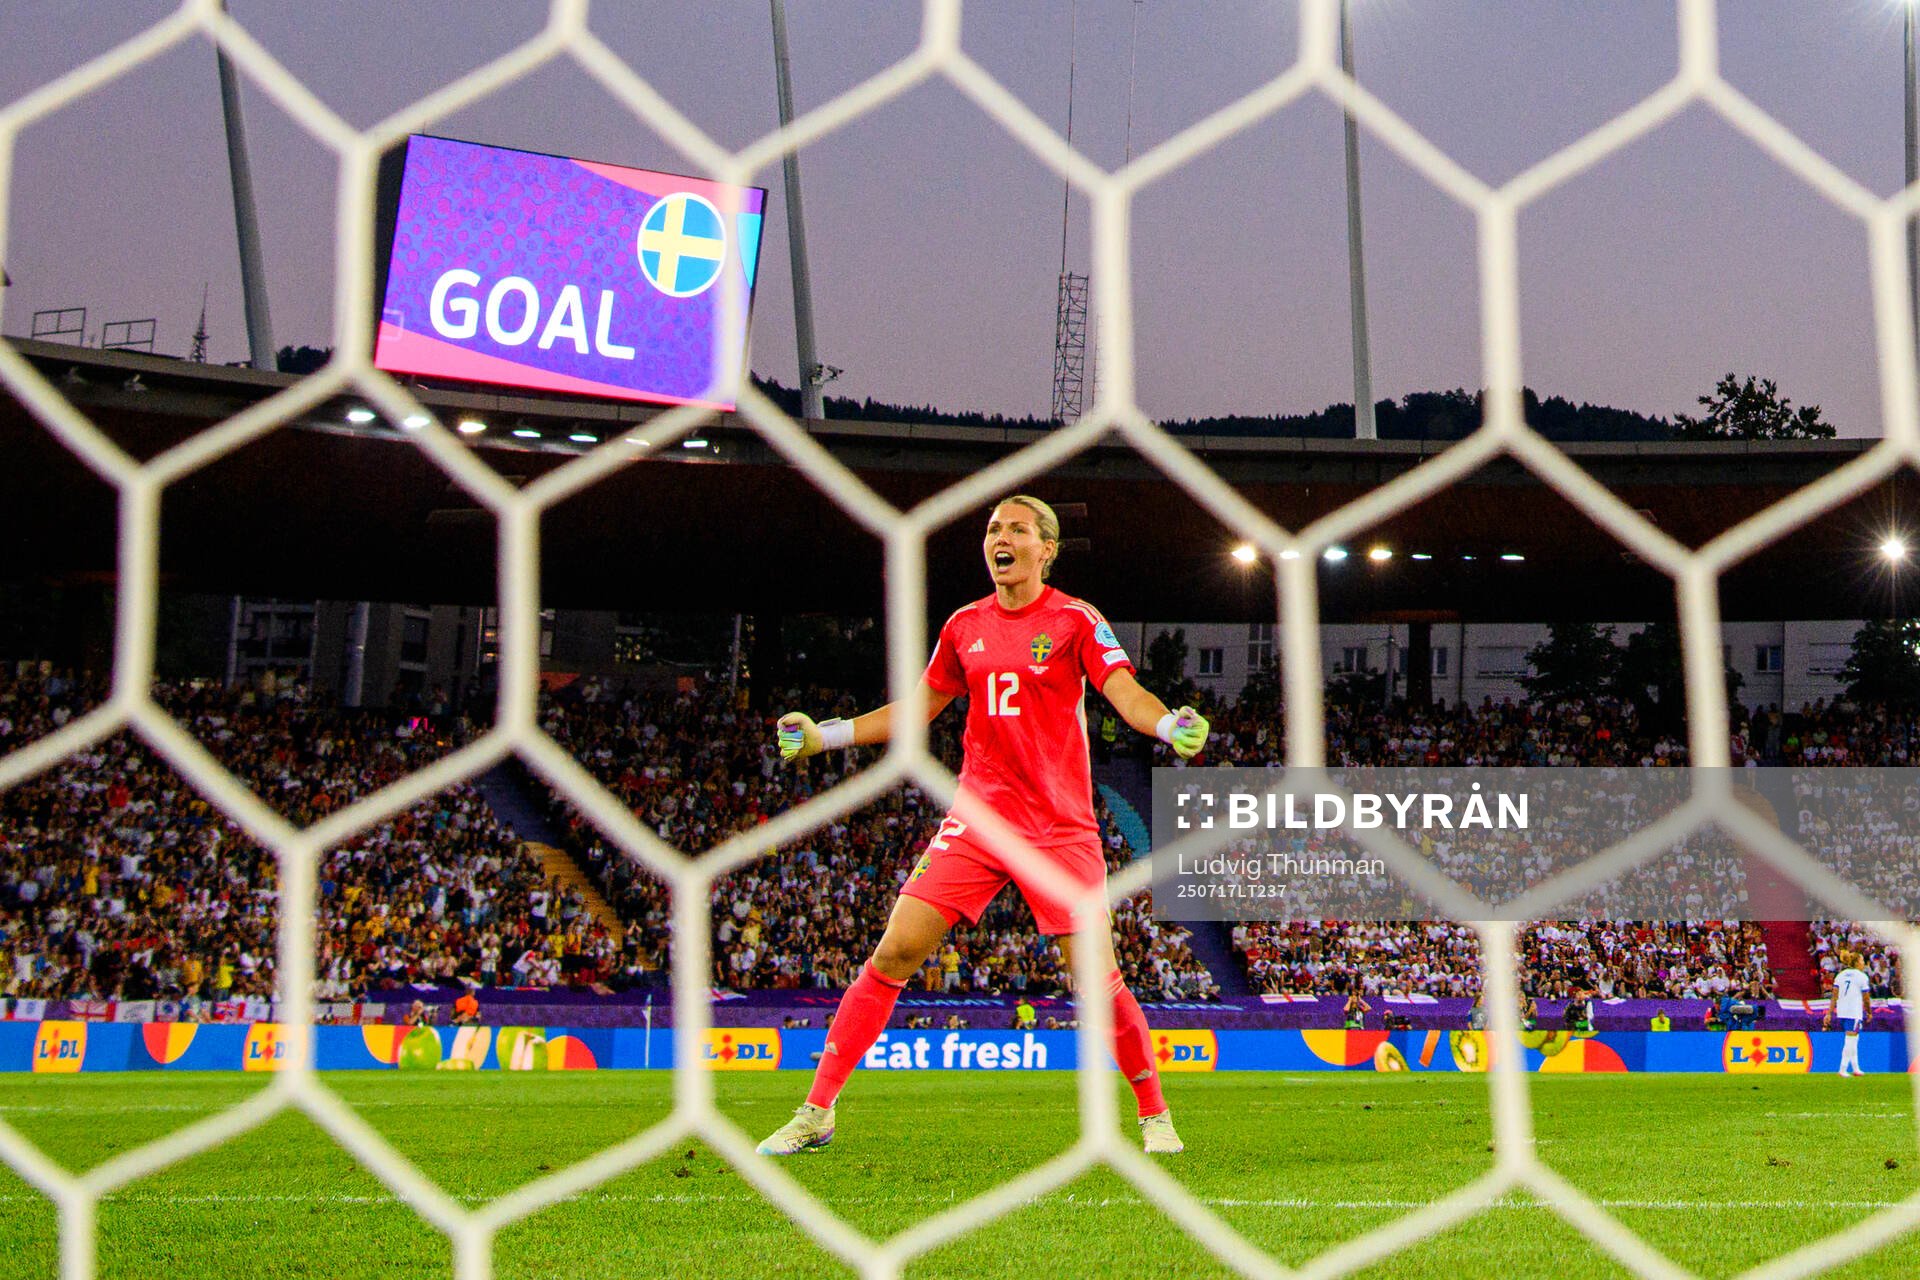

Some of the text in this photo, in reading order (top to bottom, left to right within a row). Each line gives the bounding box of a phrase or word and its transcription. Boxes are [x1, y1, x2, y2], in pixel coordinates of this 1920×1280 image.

[430, 268, 636, 360] GOAL
[987, 672, 1021, 716] 12
[1844, 980, 1851, 997] 7
[865, 1032, 1047, 1069] Eat fresh
